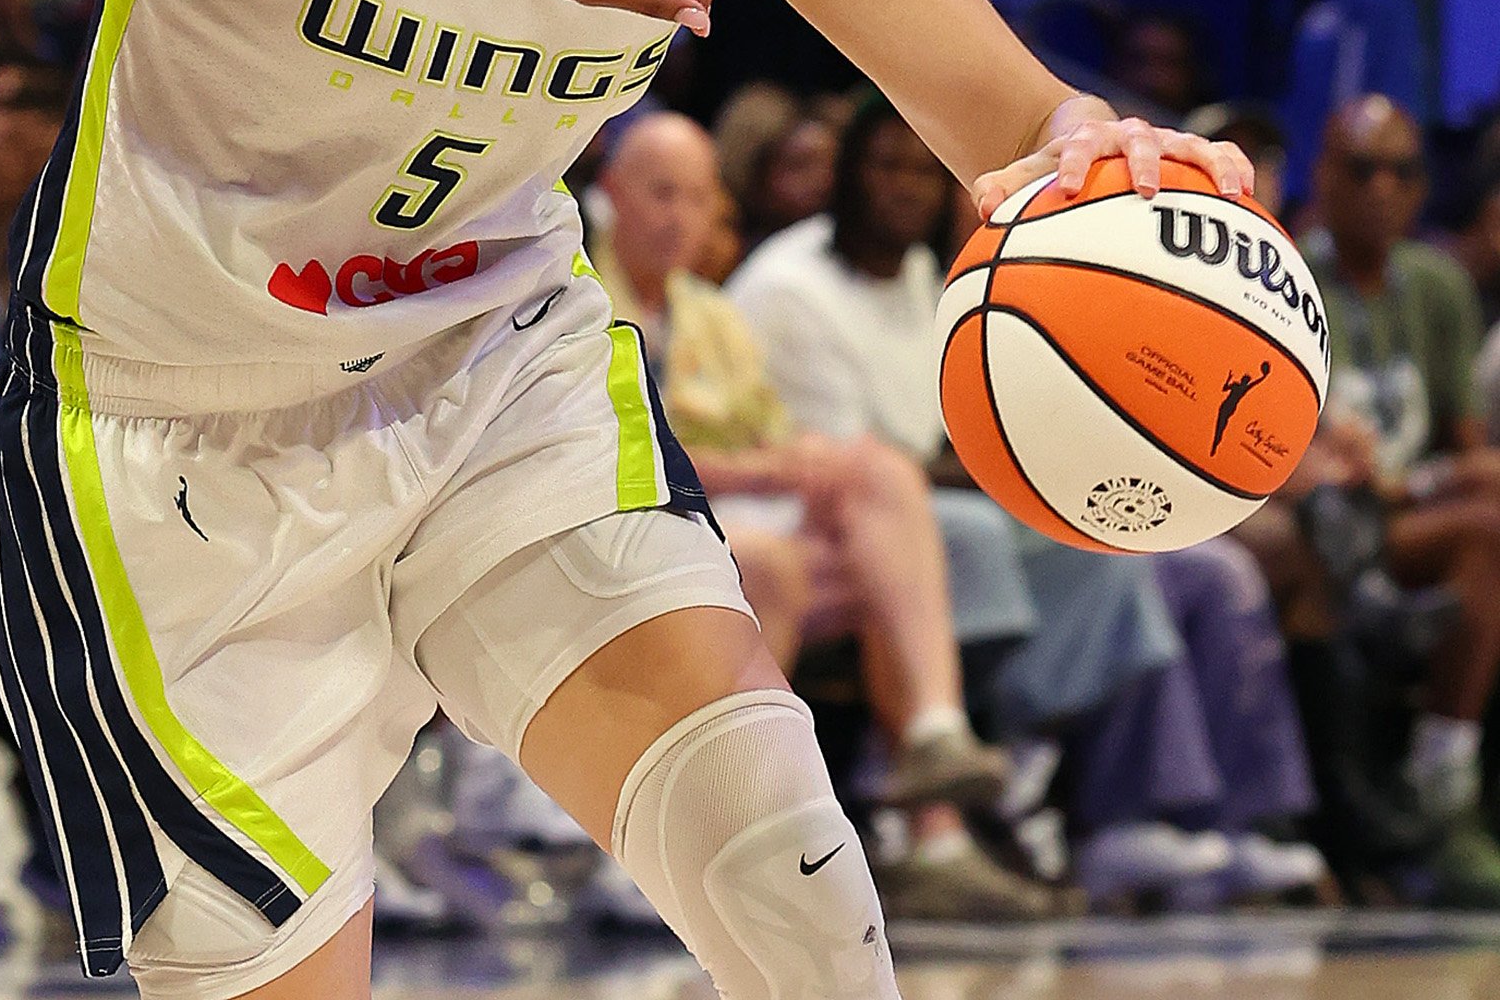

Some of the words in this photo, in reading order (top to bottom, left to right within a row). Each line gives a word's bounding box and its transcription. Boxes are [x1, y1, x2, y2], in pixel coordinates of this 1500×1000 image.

[328, 69, 579, 130] DALLA
[368, 129, 497, 231] 5
[1152, 205, 1330, 376] Wilson
[1243, 292, 1268, 310] EVO
[1125, 351, 1167, 380] GAME
[1166, 376, 1198, 402] BALL
[1140, 345, 1196, 386] OFFICIAL
